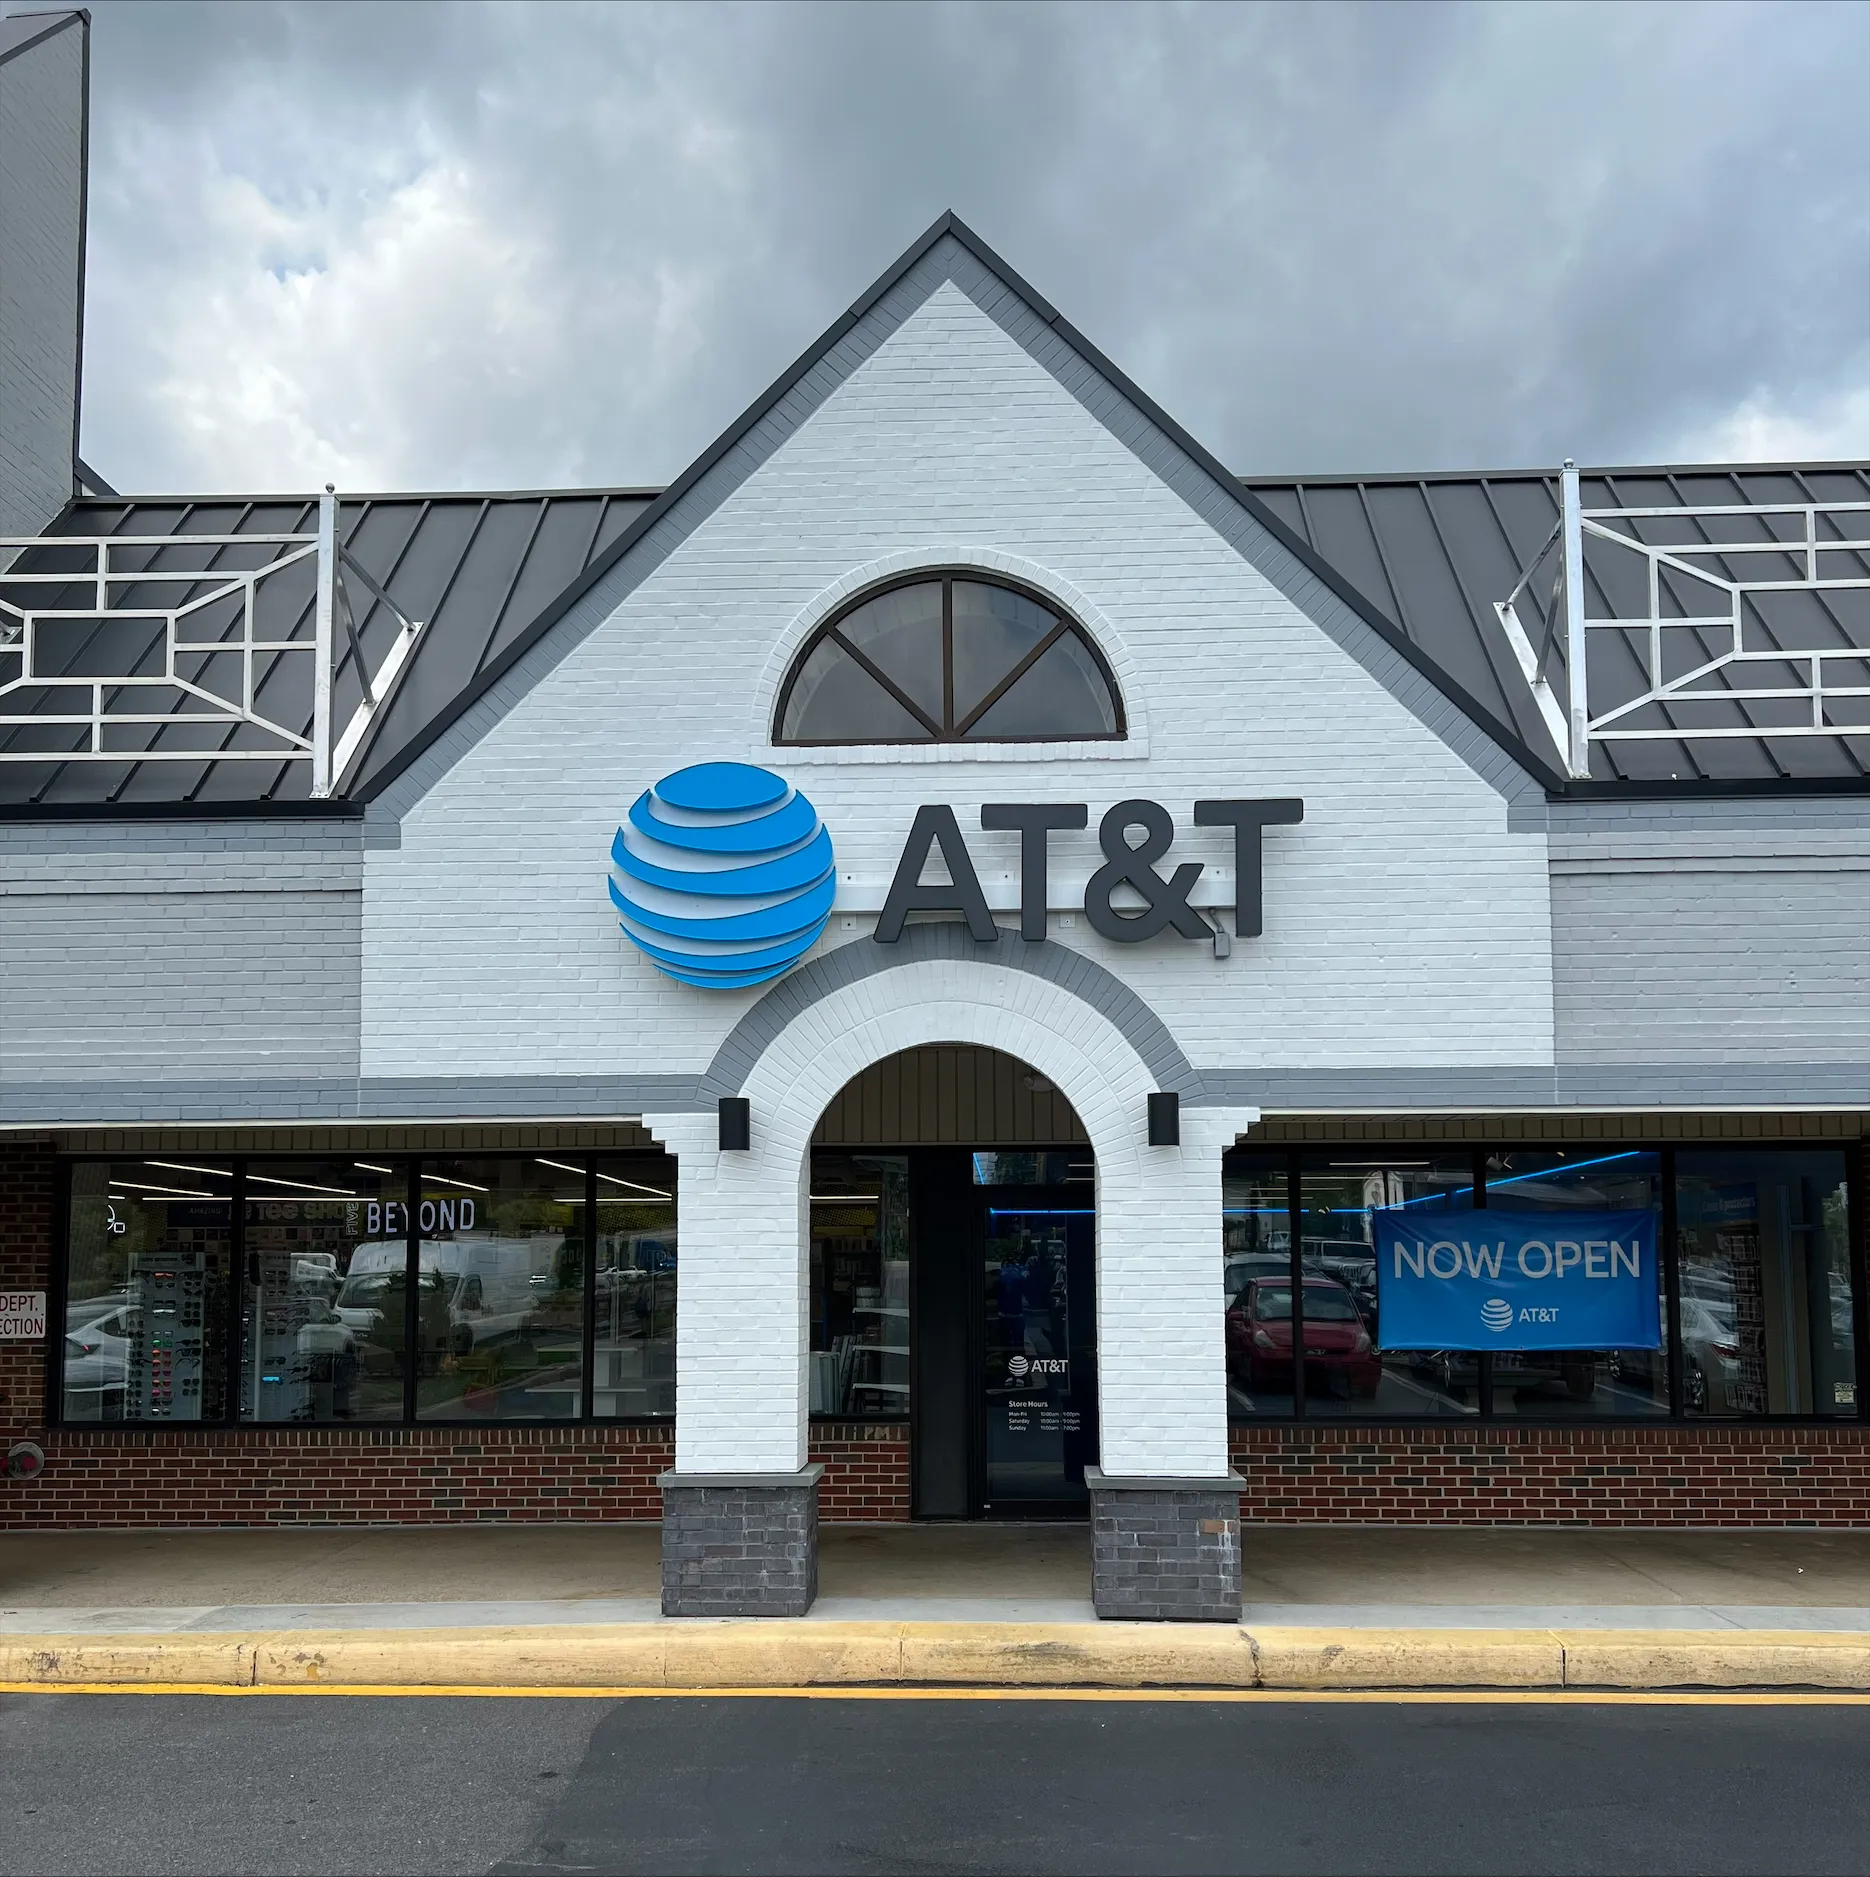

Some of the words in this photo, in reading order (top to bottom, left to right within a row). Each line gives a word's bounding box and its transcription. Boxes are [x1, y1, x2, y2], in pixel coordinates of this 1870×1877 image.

[874, 798, 1304, 943] AT&T
[345, 1202, 360, 1236] FIVE
[367, 1199, 475, 1234] BEYOND
[1394, 1241, 1506, 1279] NOW
[1517, 1240, 1641, 1279] OPEN
[0, 1295, 38, 1312] DEPT.
[1519, 1308, 1560, 1323] AT&T
[1031, 1359, 1069, 1373] AT&T
[1008, 1400, 1027, 1408] Store
[1027, 1400, 1049, 1408] Hours
